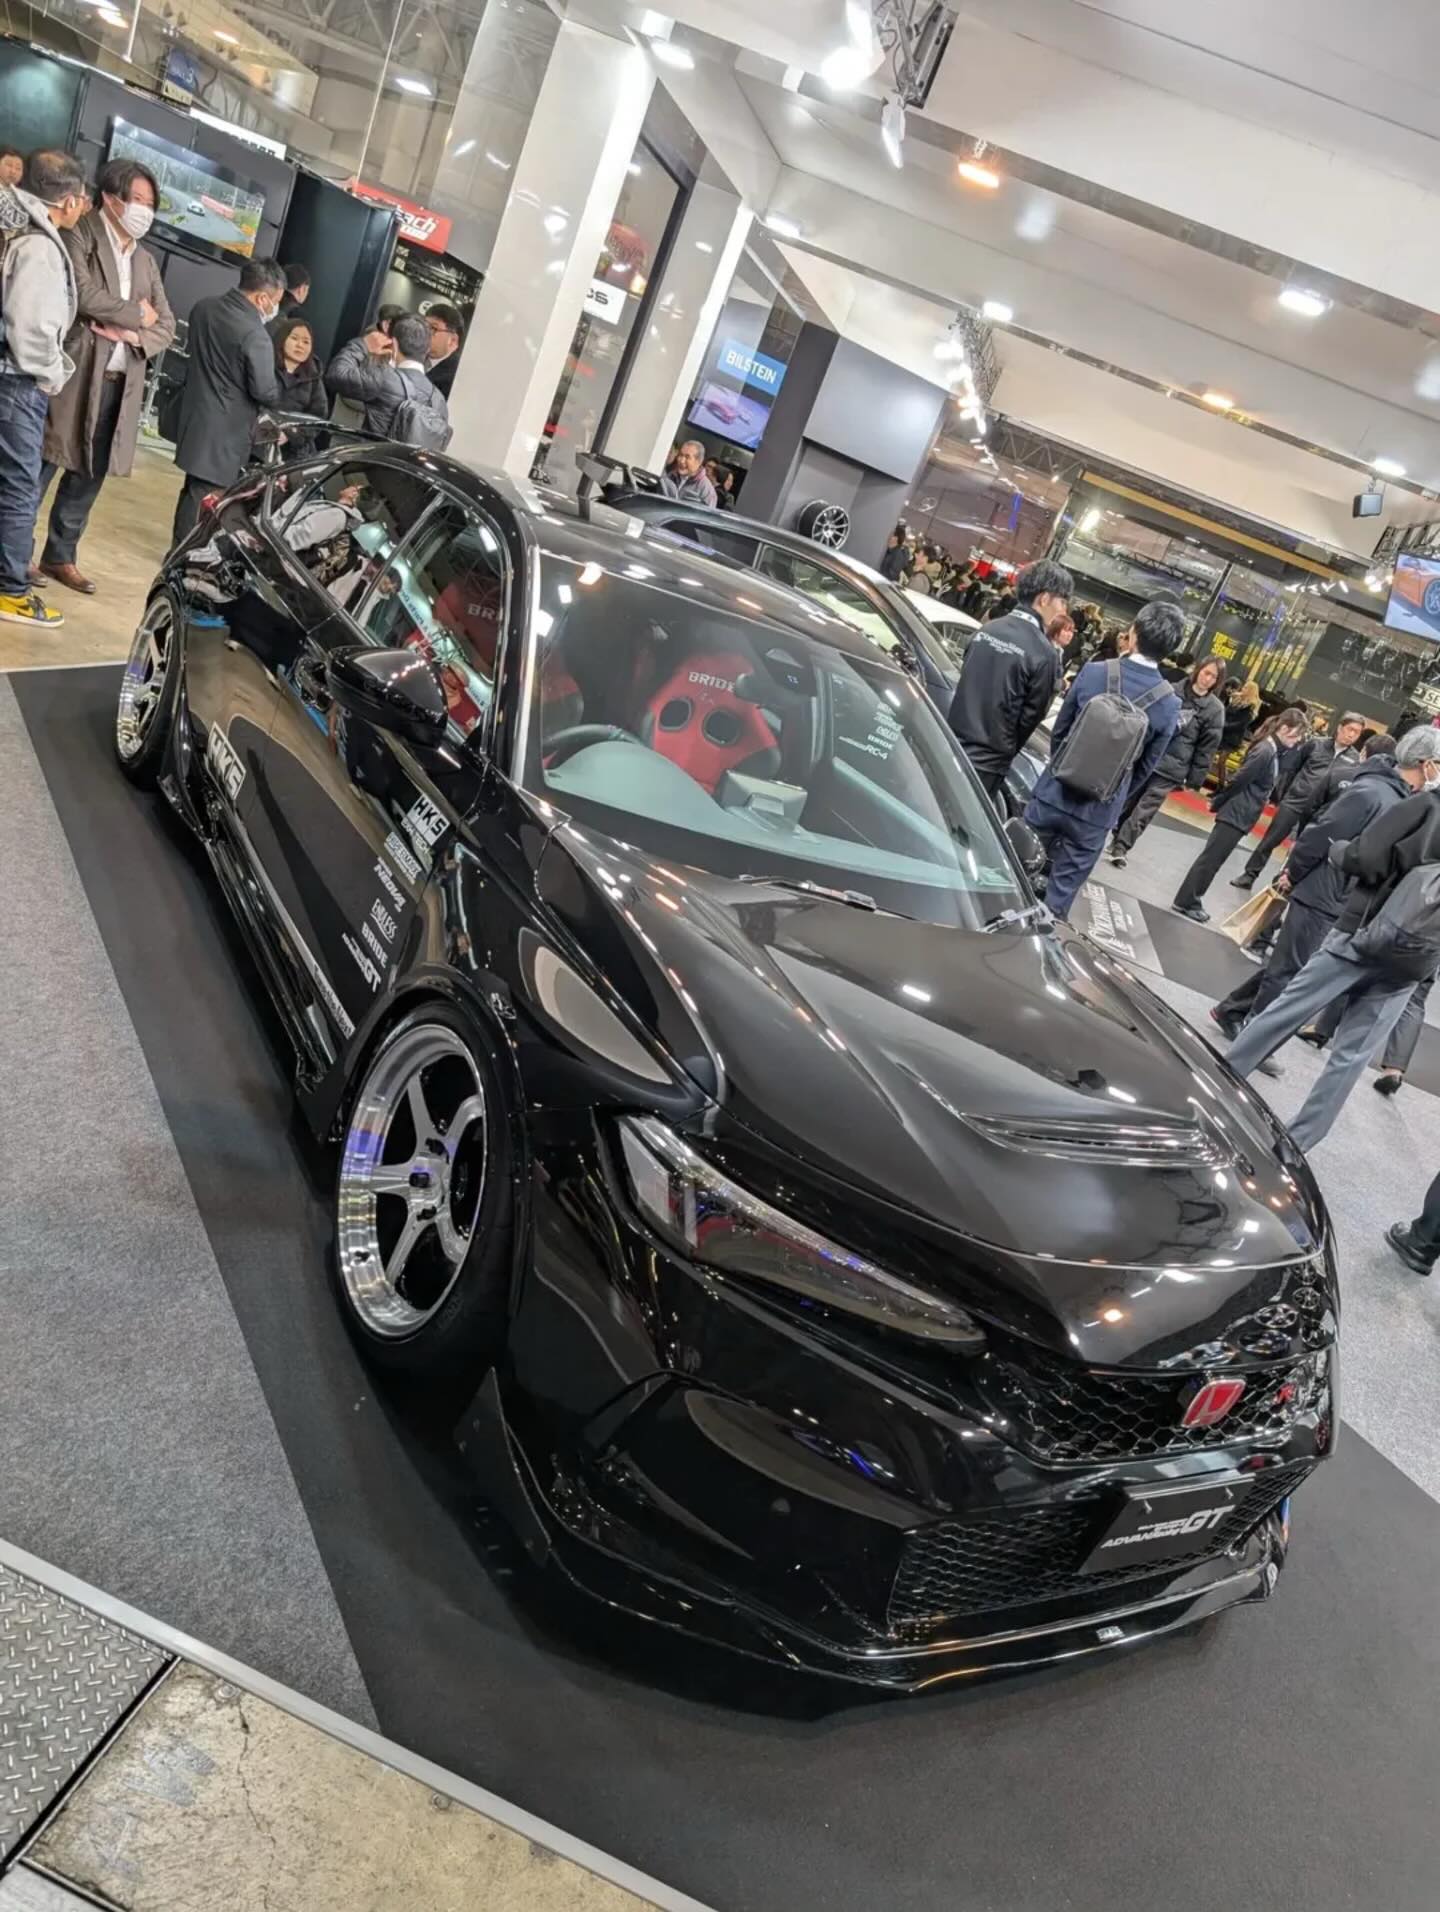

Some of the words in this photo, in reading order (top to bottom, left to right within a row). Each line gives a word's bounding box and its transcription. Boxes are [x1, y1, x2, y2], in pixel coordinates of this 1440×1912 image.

[726, 350, 778, 384] BILSTEIN
[688, 671, 736, 692] BRIDE
[207, 725, 245, 799] HKS
[412, 796, 448, 838] HKS
[374, 863, 406, 907] NEOVA
[370, 898, 397, 941] ENDLESS
[361, 921, 388, 969] BRIDE
[1180, 1504, 1237, 1534] GT
